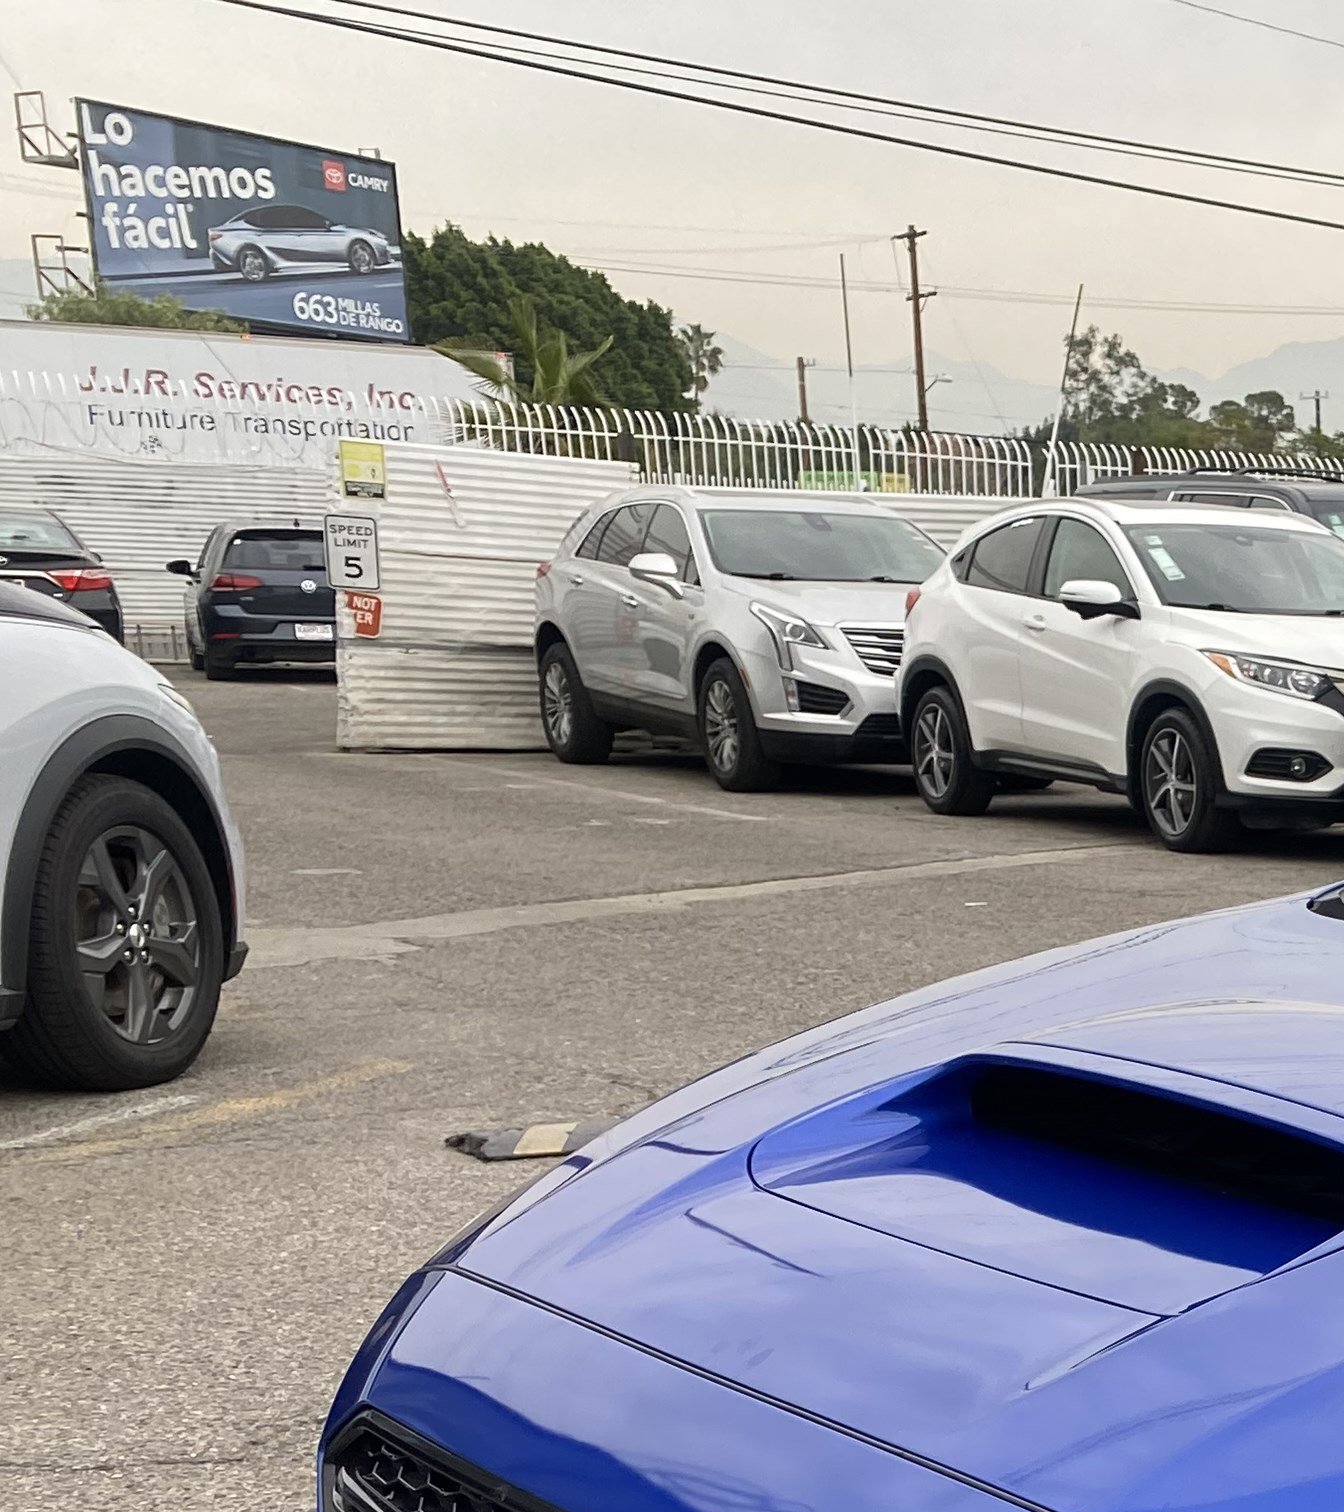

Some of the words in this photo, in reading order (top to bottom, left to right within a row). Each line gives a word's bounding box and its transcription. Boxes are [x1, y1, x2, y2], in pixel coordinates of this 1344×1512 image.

[82, 103, 133, 146] Lo
[87, 150, 275, 199] hacemos
[348, 173, 388, 193] CAMRY
[101, 202, 198, 249] fácil
[293, 292, 338, 324] 663
[338, 298, 380, 316] MILLAS
[339, 311, 357, 327] DE
[359, 314, 404, 333] RANGO
[367, 383, 424, 411] Inc.
[88, 404, 216, 431] Furniture
[329, 524, 373, 536] SPEED
[334, 538, 369, 549] LIMIT
[344, 556, 363, 578] 5
[352, 596, 378, 610] NOT
